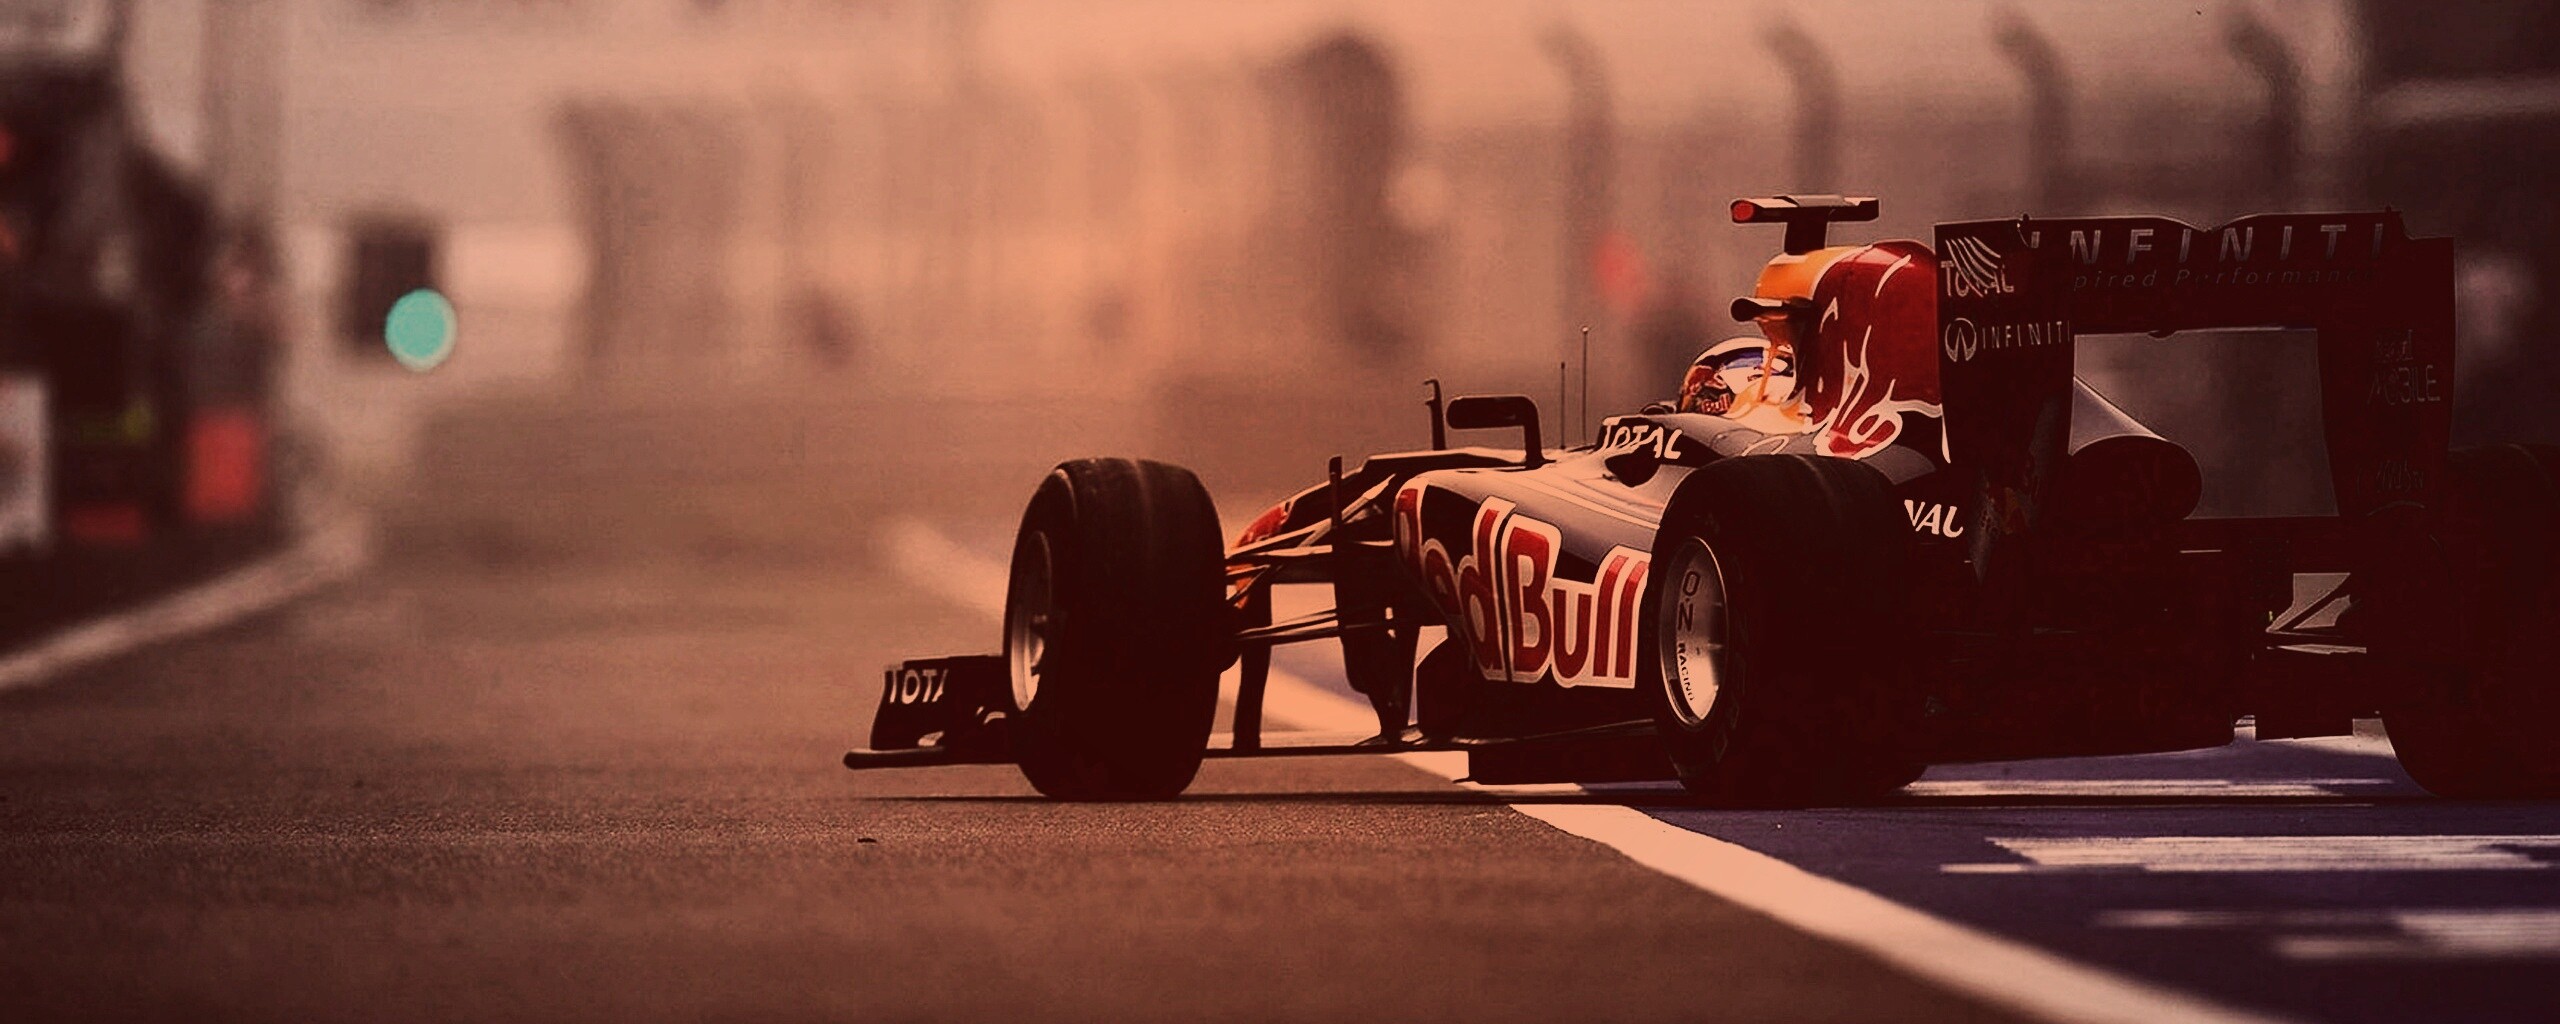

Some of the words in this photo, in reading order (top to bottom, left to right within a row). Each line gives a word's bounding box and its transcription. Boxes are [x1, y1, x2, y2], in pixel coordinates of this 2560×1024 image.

[1982, 320, 2071, 350] INFINITI
[1599, 417, 1682, 459] TOTAL
[1502, 516, 1651, 687] Bull
